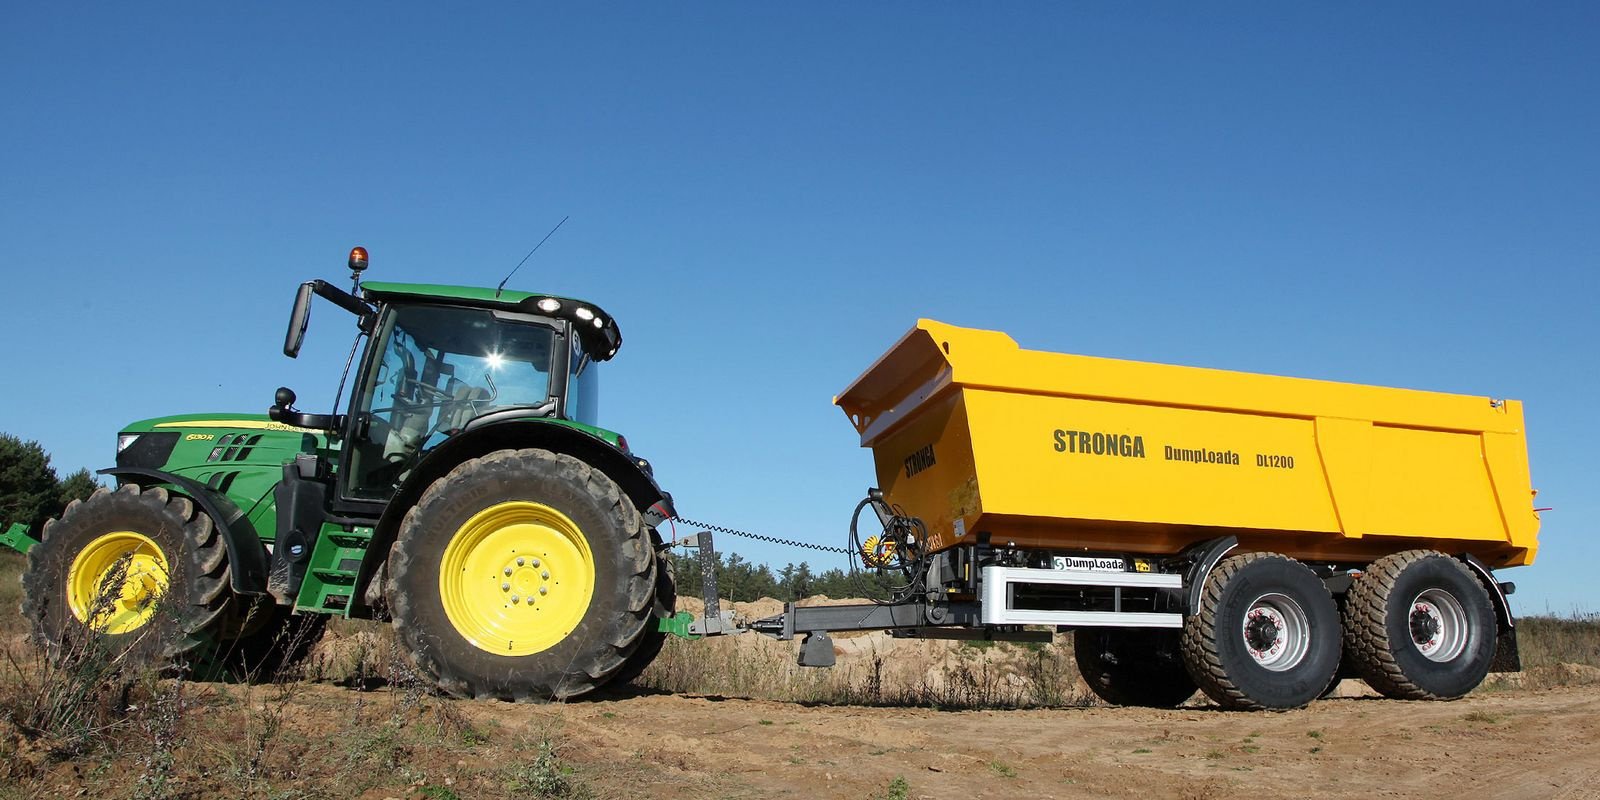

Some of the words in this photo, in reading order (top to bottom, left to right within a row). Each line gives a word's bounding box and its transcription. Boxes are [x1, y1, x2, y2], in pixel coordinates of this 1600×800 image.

[264, 422, 288, 431] JOHN
[904, 443, 936, 479] STRONGA
[1053, 429, 1145, 458] STRONGA
[1164, 445, 1240, 465] DumpLoada
[1256, 453, 1294, 469] DL1200
[1065, 557, 1124, 570] DumpLoada
